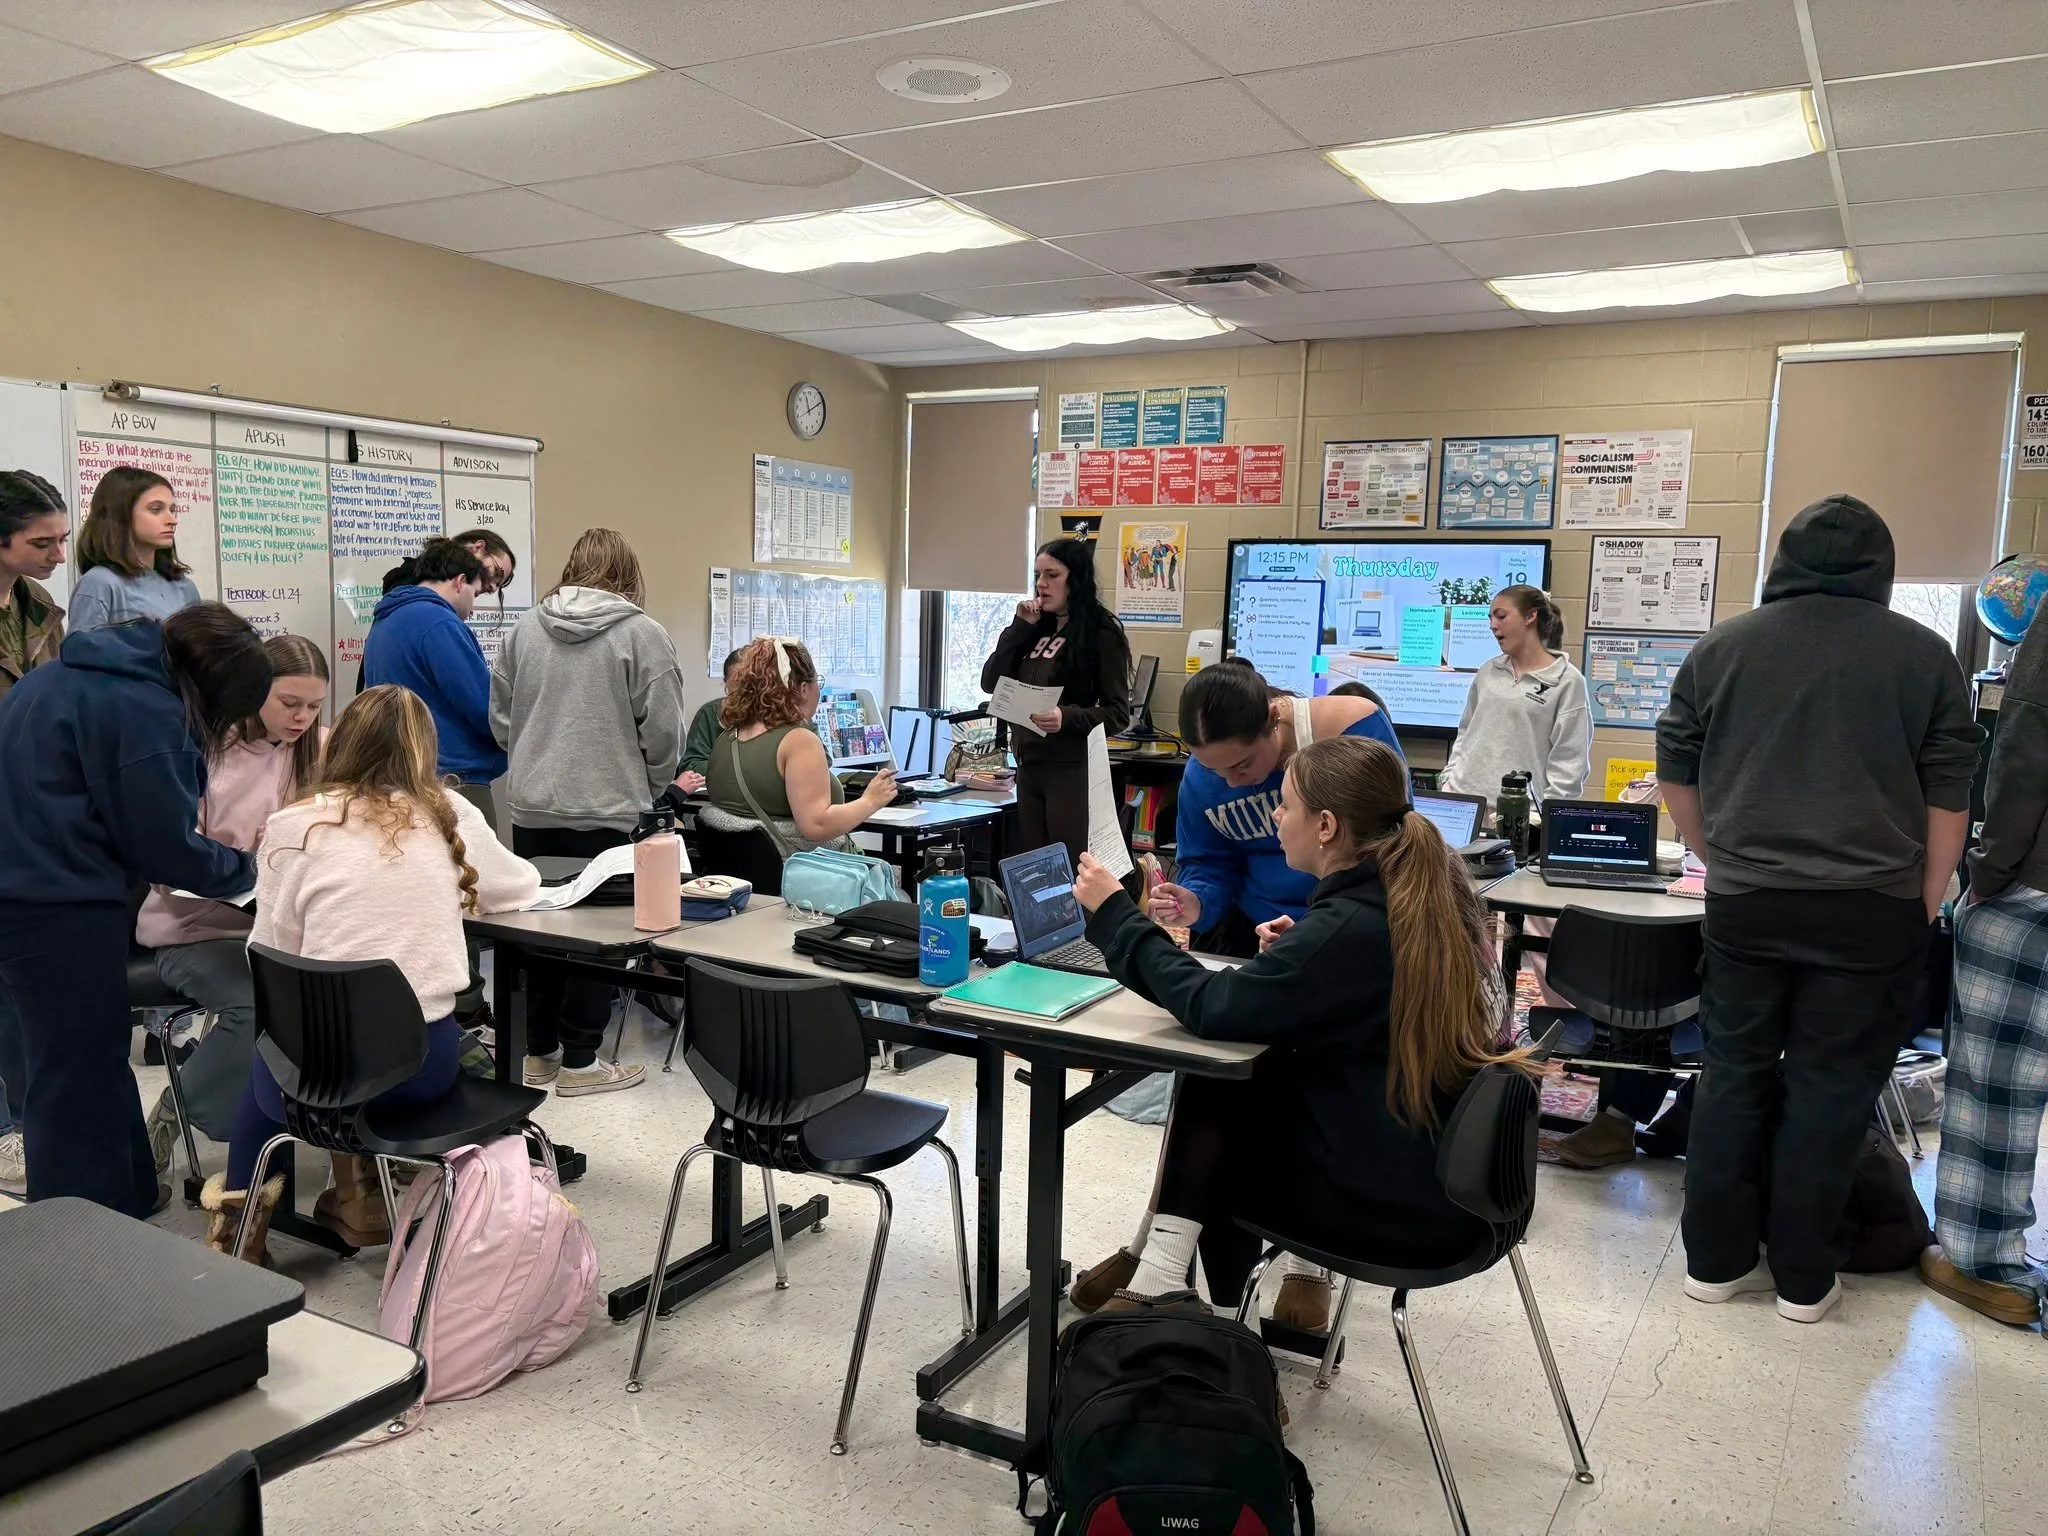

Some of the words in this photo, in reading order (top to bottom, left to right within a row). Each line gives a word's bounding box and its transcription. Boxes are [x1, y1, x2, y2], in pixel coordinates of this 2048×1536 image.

[2034, 397, 2048, 406] PER
[111, 411, 128, 430] AP
[132, 414, 157, 431] GOV
[2027, 408, 2048, 421] 149
[244, 427, 286, 447] APUSH
[177, 453, 192, 463] the
[367, 446, 412, 465] HISTORY
[1578, 453, 1635, 463] SOCIALISM
[253, 457, 273, 472] HOW
[453, 456, 499, 472] ADVISORY
[1570, 464, 1634, 474] COMMUNISM
[218, 470, 243, 485] UNITY
[351, 469, 368, 482] How
[1588, 475, 1633, 485] FASCISM
[80, 483, 94, 496] the
[331, 483, 363, 495] between
[239, 497, 255, 509] THE
[331, 495, 364, 507] combine
[364, 498, 383, 508] with
[455, 498, 467, 511] HS
[495, 501, 511, 515] Day
[219, 510, 238, 521] AND
[270, 512, 301, 524] DEGREE
[331, 508, 339, 518] of
[340, 509, 374, 520] economic
[374, 510, 395, 520] boom
[426, 512, 440, 521] and
[476, 514, 495, 526] 3/20
[333, 519, 356, 532] global
[356, 521, 371, 530] war
[413, 523, 429, 534] both
[355, 534, 384, 546] America
[1605, 540, 1644, 549] SHADOW
[221, 551, 253, 566] SOCIETY
[1257, 551, 1286, 563] 12:15
[1289, 551, 1309, 564] PM
[1604, 548, 1643, 558] DOCKET
[1332, 555, 1440, 582] Thursday
[1505, 571, 1528, 587] 19
[361, 584, 384, 597] Harbo
[352, 597, 377, 610] Thurs
[1029, 636, 1066, 659] 99
[1610, 764, 1627, 774] Pick
[1628, 767, 1638, 776] up
[1204, 789, 1283, 841] MILW
[1160, 1516, 1201, 1529] LIWAG
